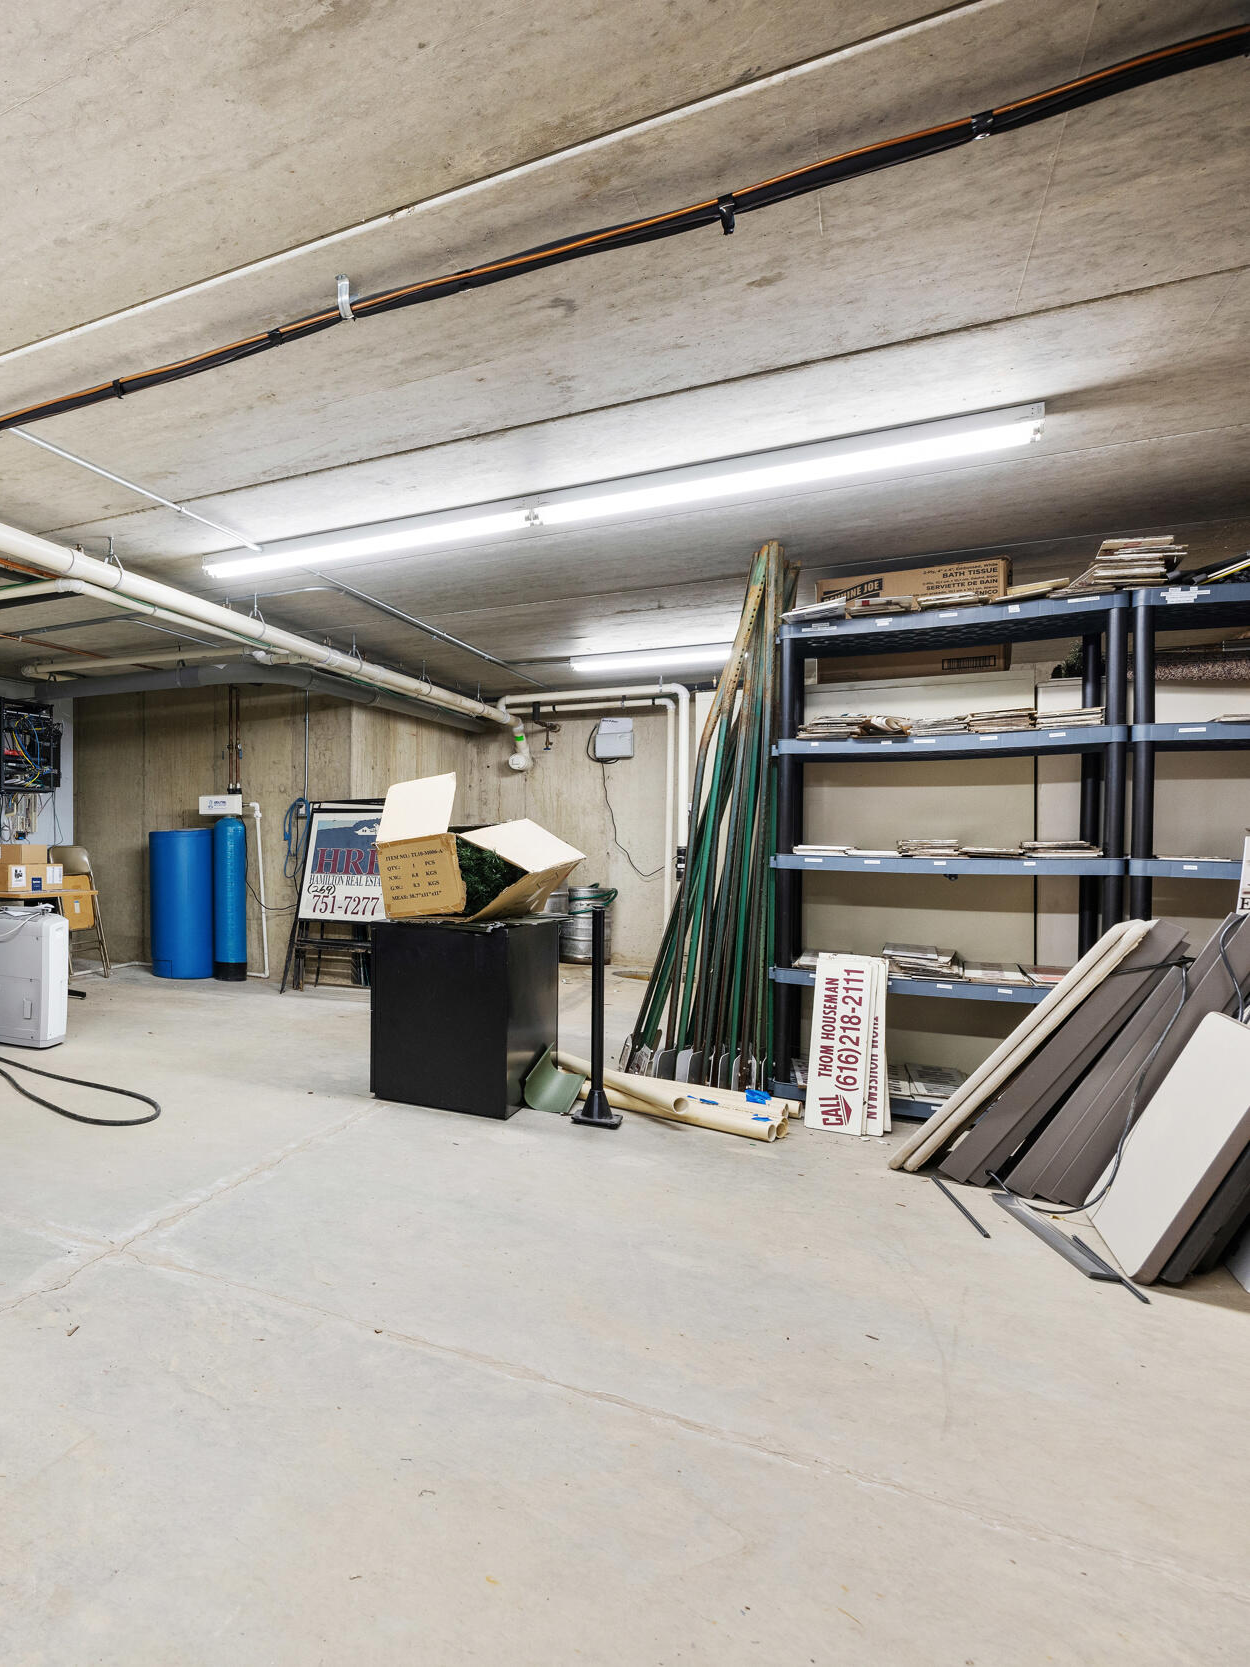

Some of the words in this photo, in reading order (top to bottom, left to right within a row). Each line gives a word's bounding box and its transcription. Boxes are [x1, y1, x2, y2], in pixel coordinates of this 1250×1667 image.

[942, 571, 965, 579] BATH
[968, 568, 999, 576] TISSUE
[863, 581, 880, 593] JOE
[926, 582, 966, 591] SERVIETTE
[307, 883, 336, 895] (269)
[309, 874, 345, 886] HAMILTON
[346, 875, 364, 887] REAL
[312, 895, 380, 916] 751-7277
[821, 977, 840, 1041] HOUSEMAN
[835, 969, 864, 1092] (616)218-2111
[818, 1045, 835, 1078] THOM
[819, 1094, 844, 1126] CALL
